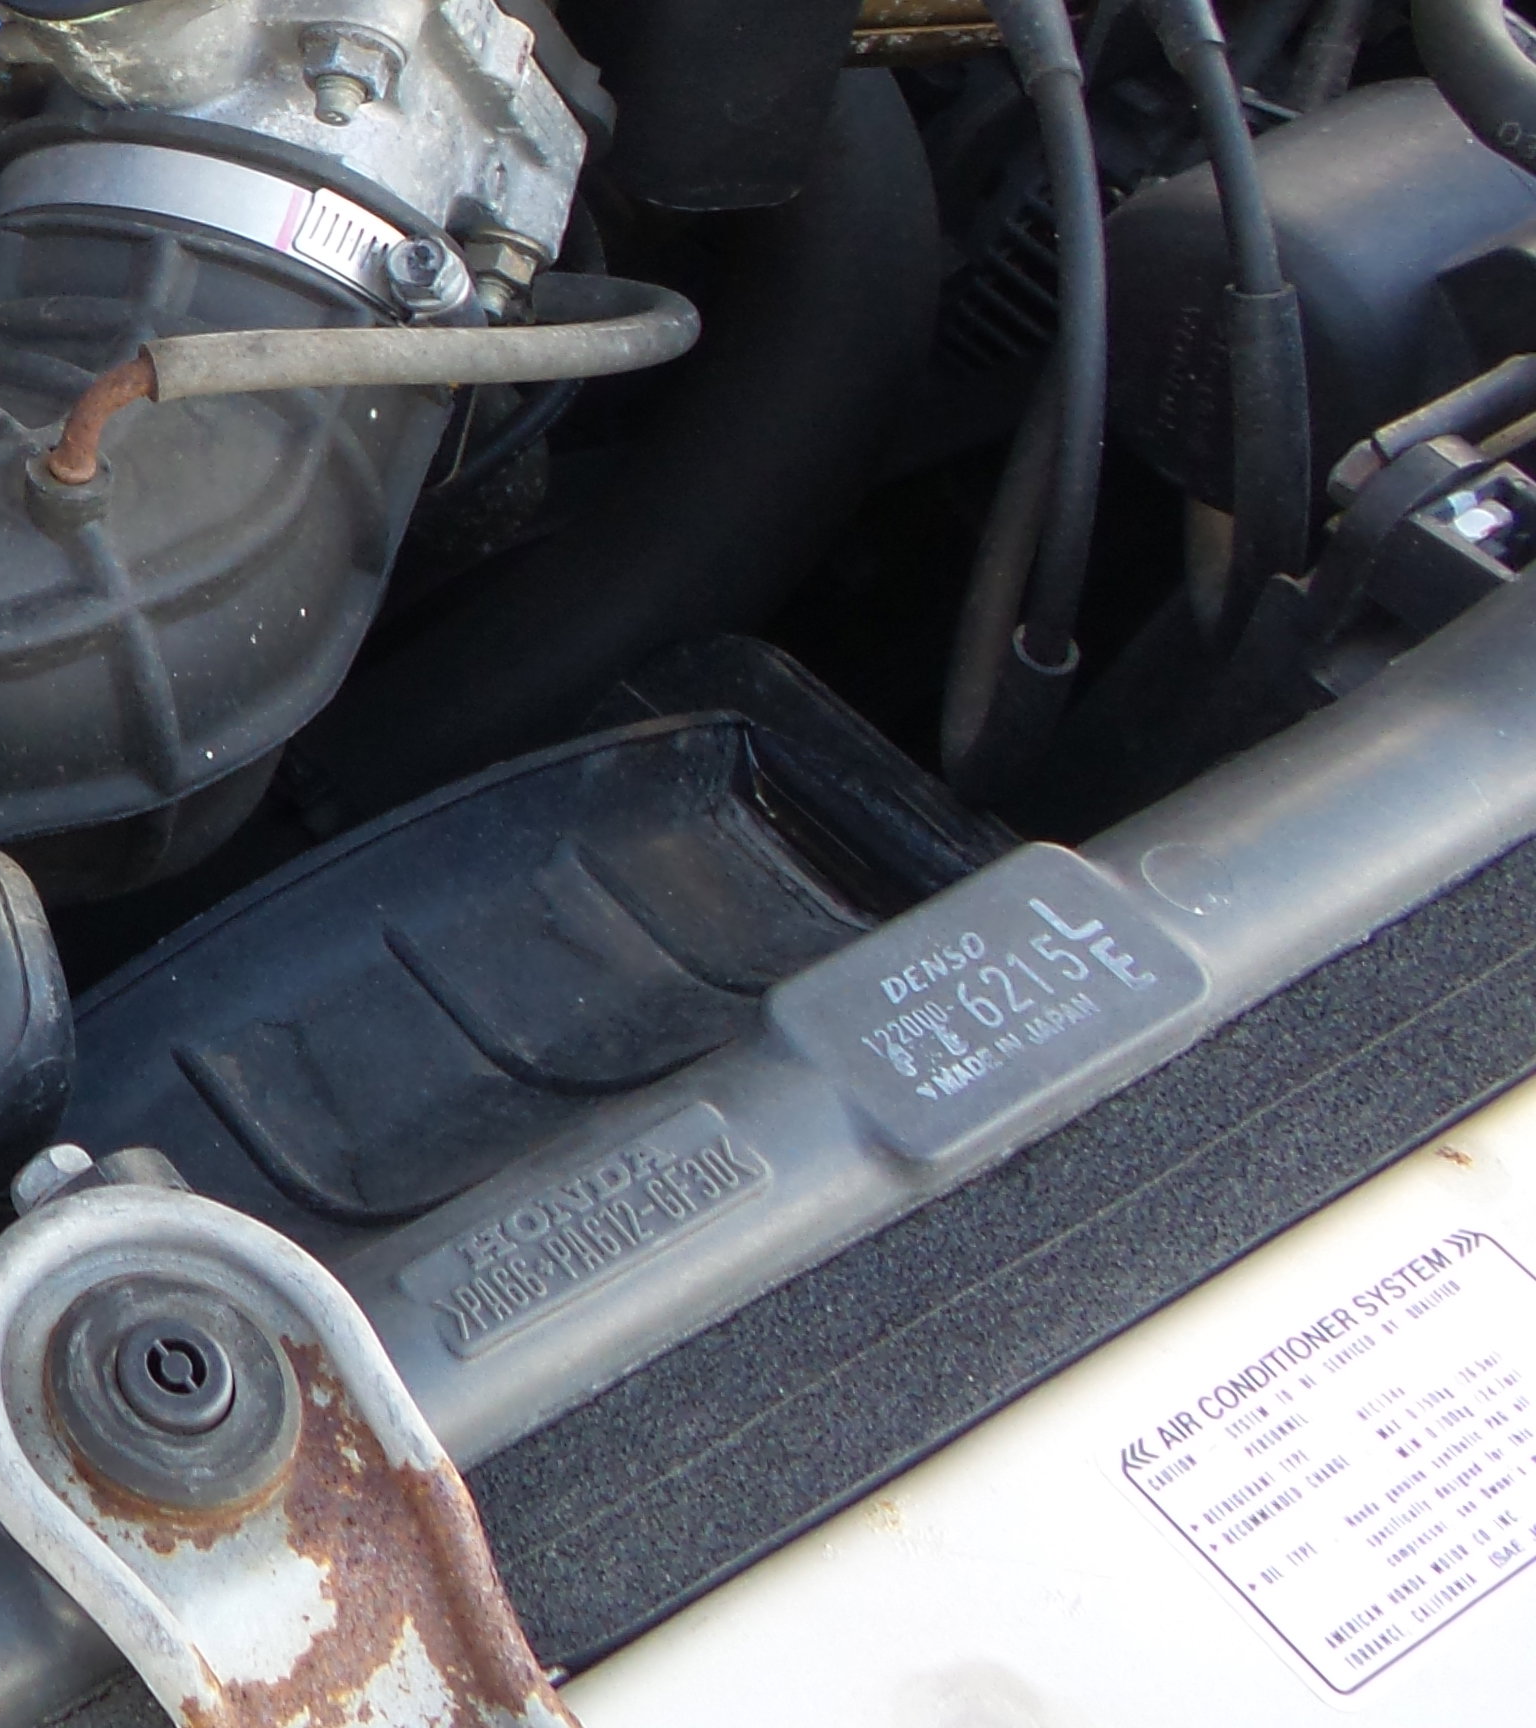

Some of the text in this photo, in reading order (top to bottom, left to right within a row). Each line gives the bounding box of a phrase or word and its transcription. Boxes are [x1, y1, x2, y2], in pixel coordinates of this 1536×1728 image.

[879, 931, 986, 1005] DENSO
[994, 1032, 1023, 1057] IN
[1024, 992, 1102, 1046] JAPAN
[455, 1136, 678, 1272] HONDA
[1146, 1453, 1198, 1492] CAUTION
[1405, 1279, 1462, 1320] QUALIFIED
[1157, 1247, 1454, 1451] AIR CONDITIONER SYSTEM
[1244, 1412, 1310, 1459] PERSONNEL
[1202, 1470, 1277, 1526] REFRIGERANT
[1279, 1448, 1311, 1473] TYPE
[1221, 1485, 1304, 1545] RECOMMENDED
[1304, 1454, 1351, 1489] CHARGE
[1260, 1565, 1285, 1585] OIL
[1286, 1541, 1318, 1567] TYPE
[1324, 1603, 1385, 1650] AMERICAN
[1387, 1574, 1427, 1604] HONDA
[1430, 1543, 1470, 1575] MOTOR
[1410, 1572, 1478, 1623] CALIFORNIA
